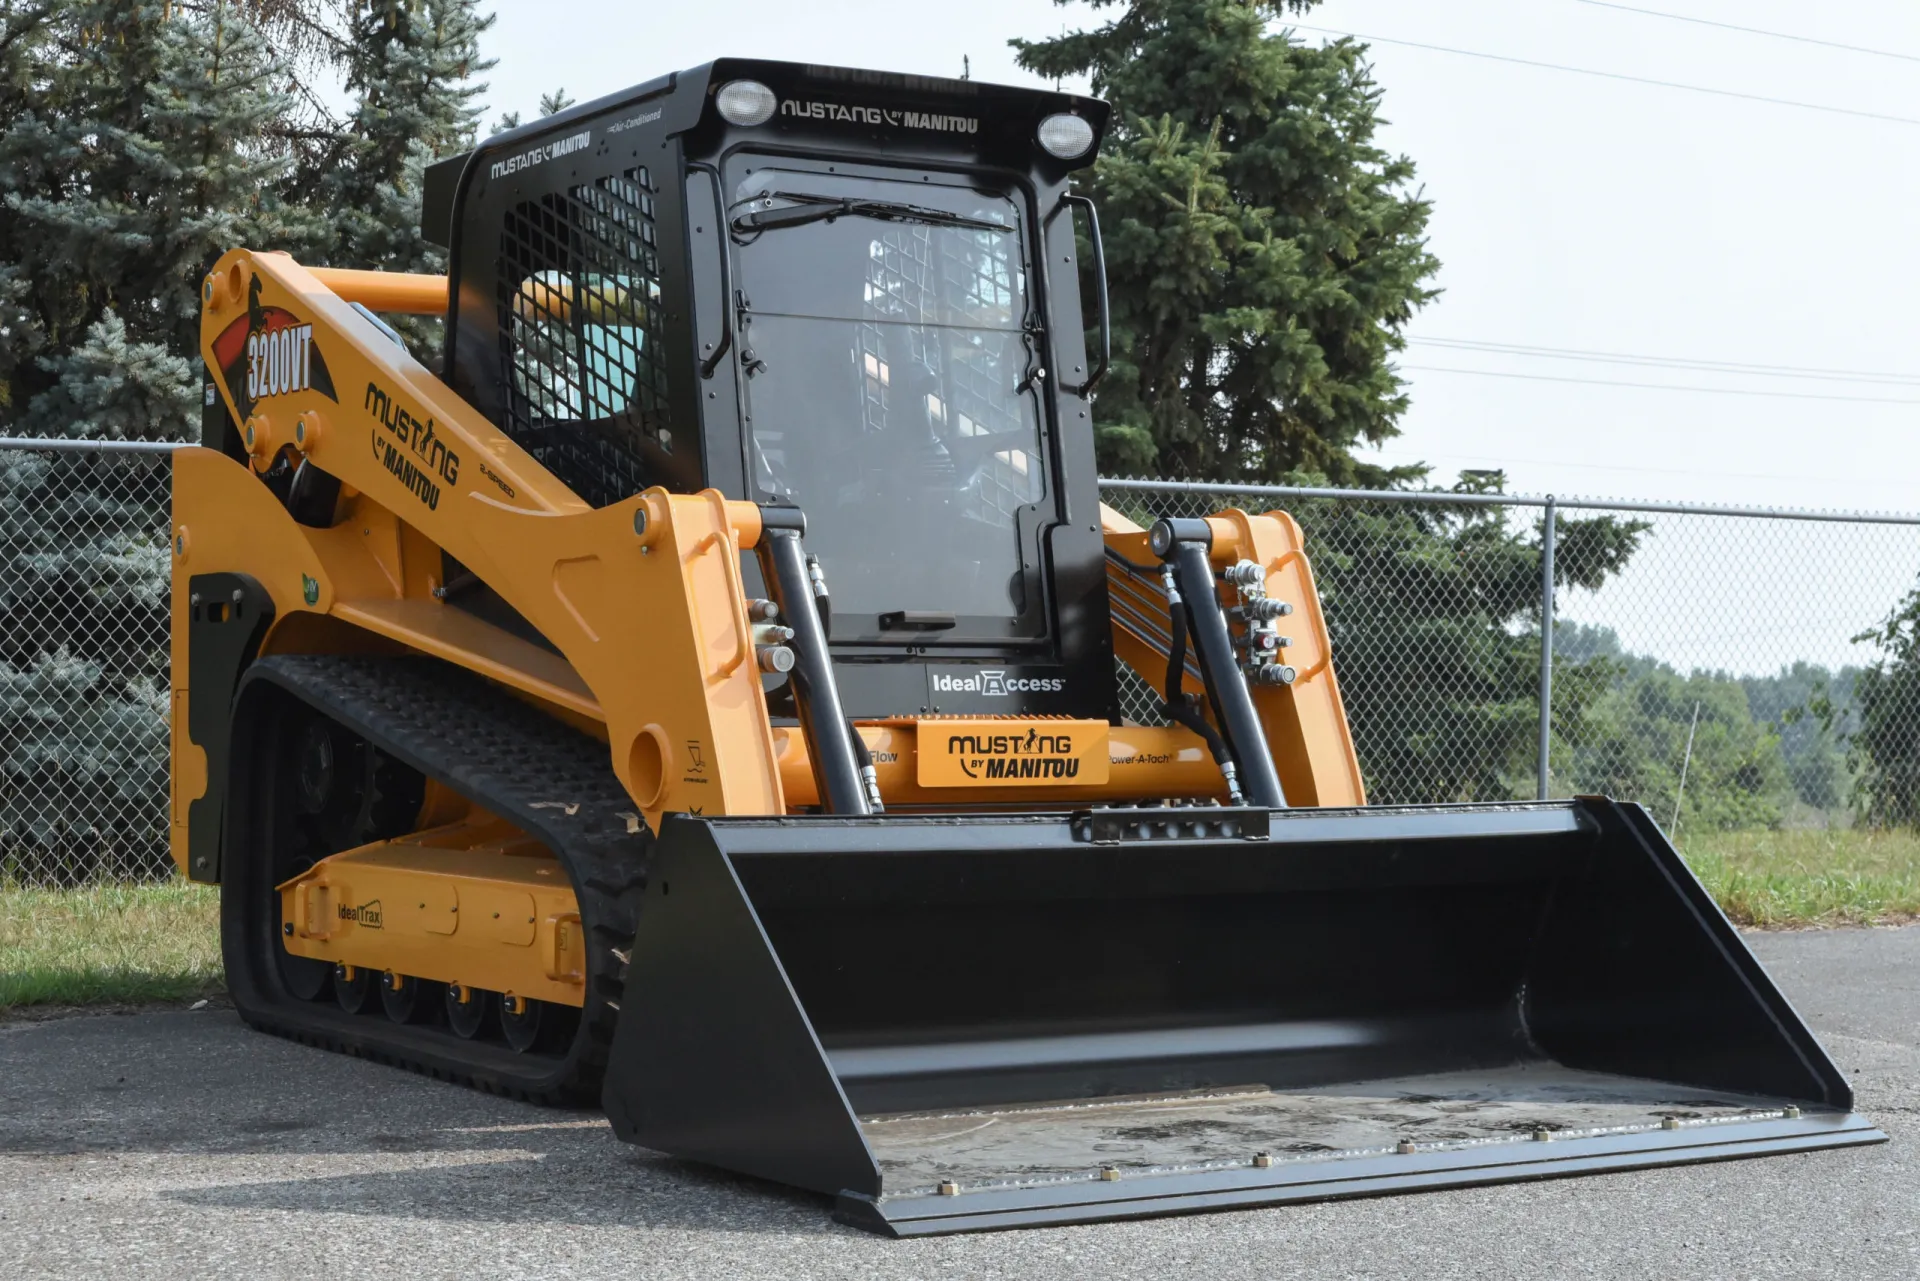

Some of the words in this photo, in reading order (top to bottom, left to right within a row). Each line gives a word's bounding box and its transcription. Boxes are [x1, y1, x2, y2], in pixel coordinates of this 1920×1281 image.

[891, 111, 902, 119] BY
[904, 112, 978, 133] MANITOU
[491, 148, 542, 179] MUSTANG
[552, 131, 591, 159] MANITOU
[248, 323, 312, 401] 3200VT
[377, 436, 386, 450] BY
[383, 444, 440, 511] MANITOU
[480, 463, 515, 498] 2-SPEED
[971, 760, 984, 768] BY
[986, 758, 1079, 778] MANITOU
